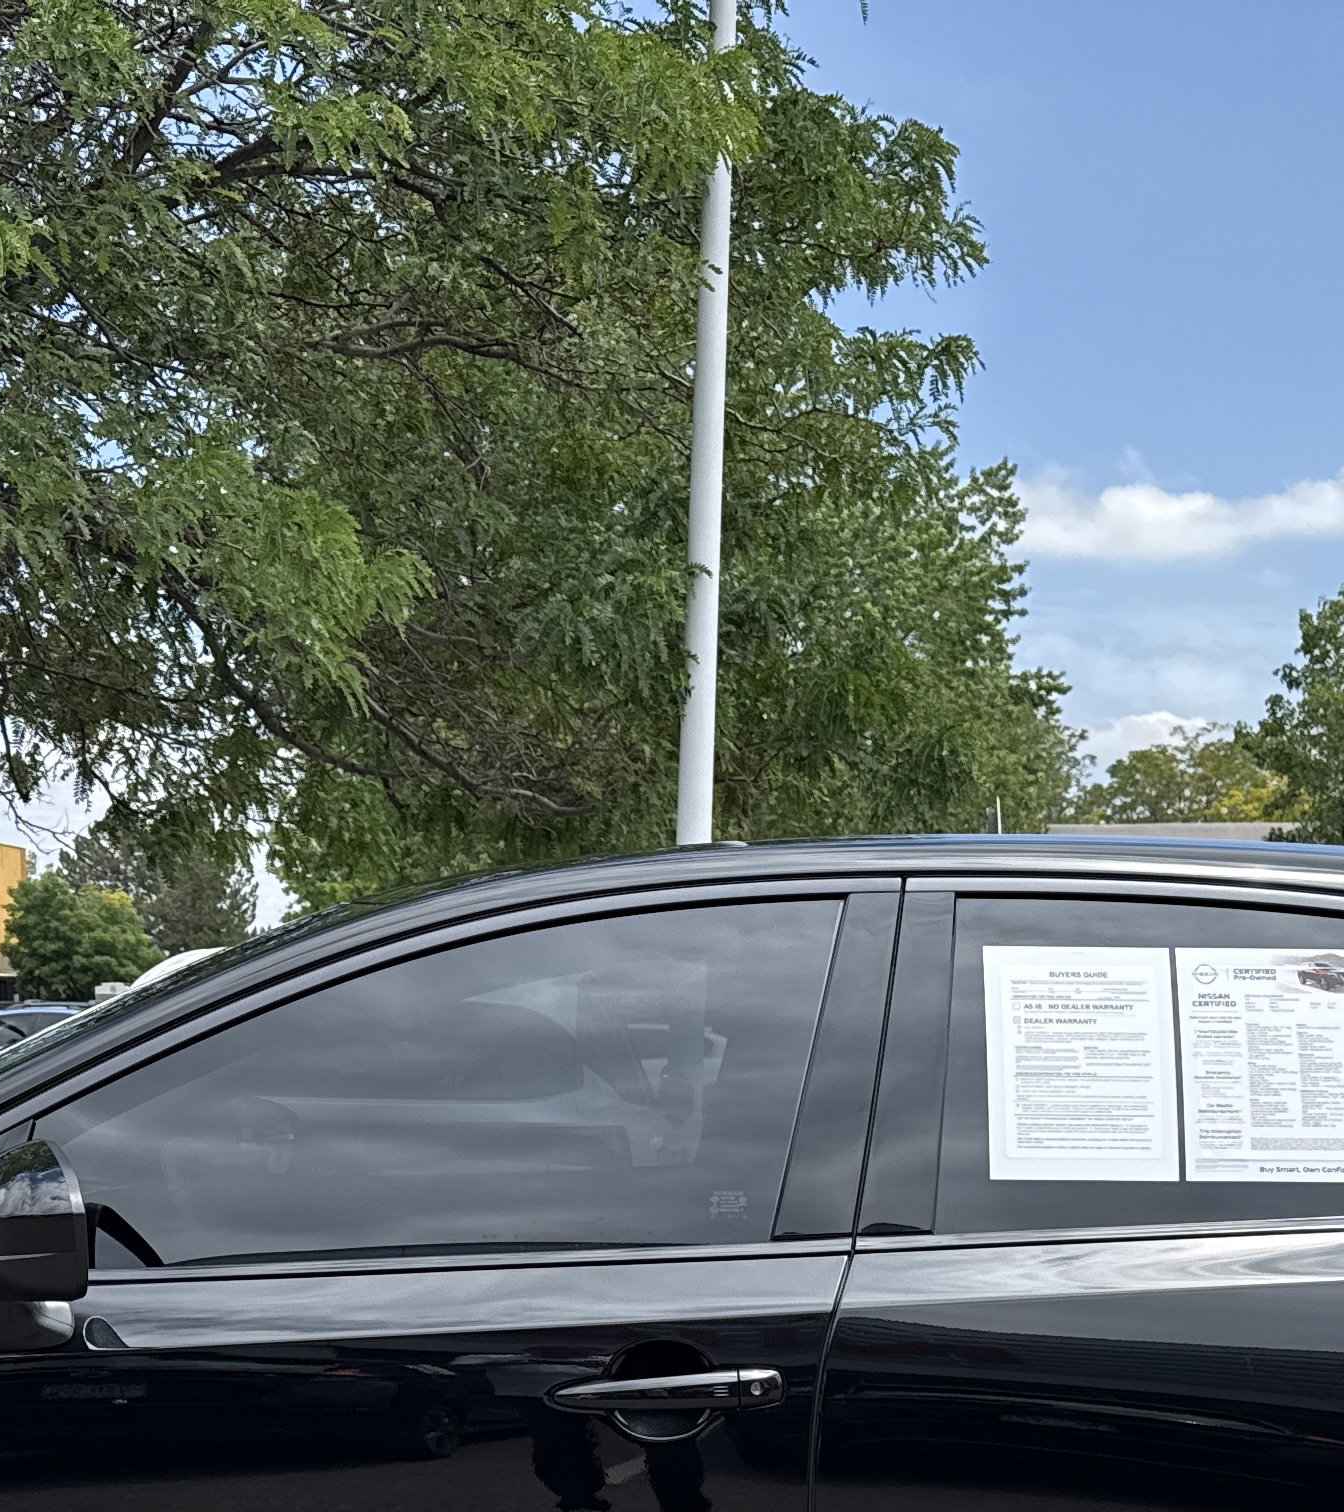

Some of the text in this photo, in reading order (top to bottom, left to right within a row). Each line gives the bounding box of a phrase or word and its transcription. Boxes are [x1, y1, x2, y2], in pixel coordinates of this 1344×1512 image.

[1049, 971, 1108, 979] BUYERS GUIDE
[1092, 1003, 1134, 1011] WARRANTY
[1259, 1166, 1274, 1174] Buy
